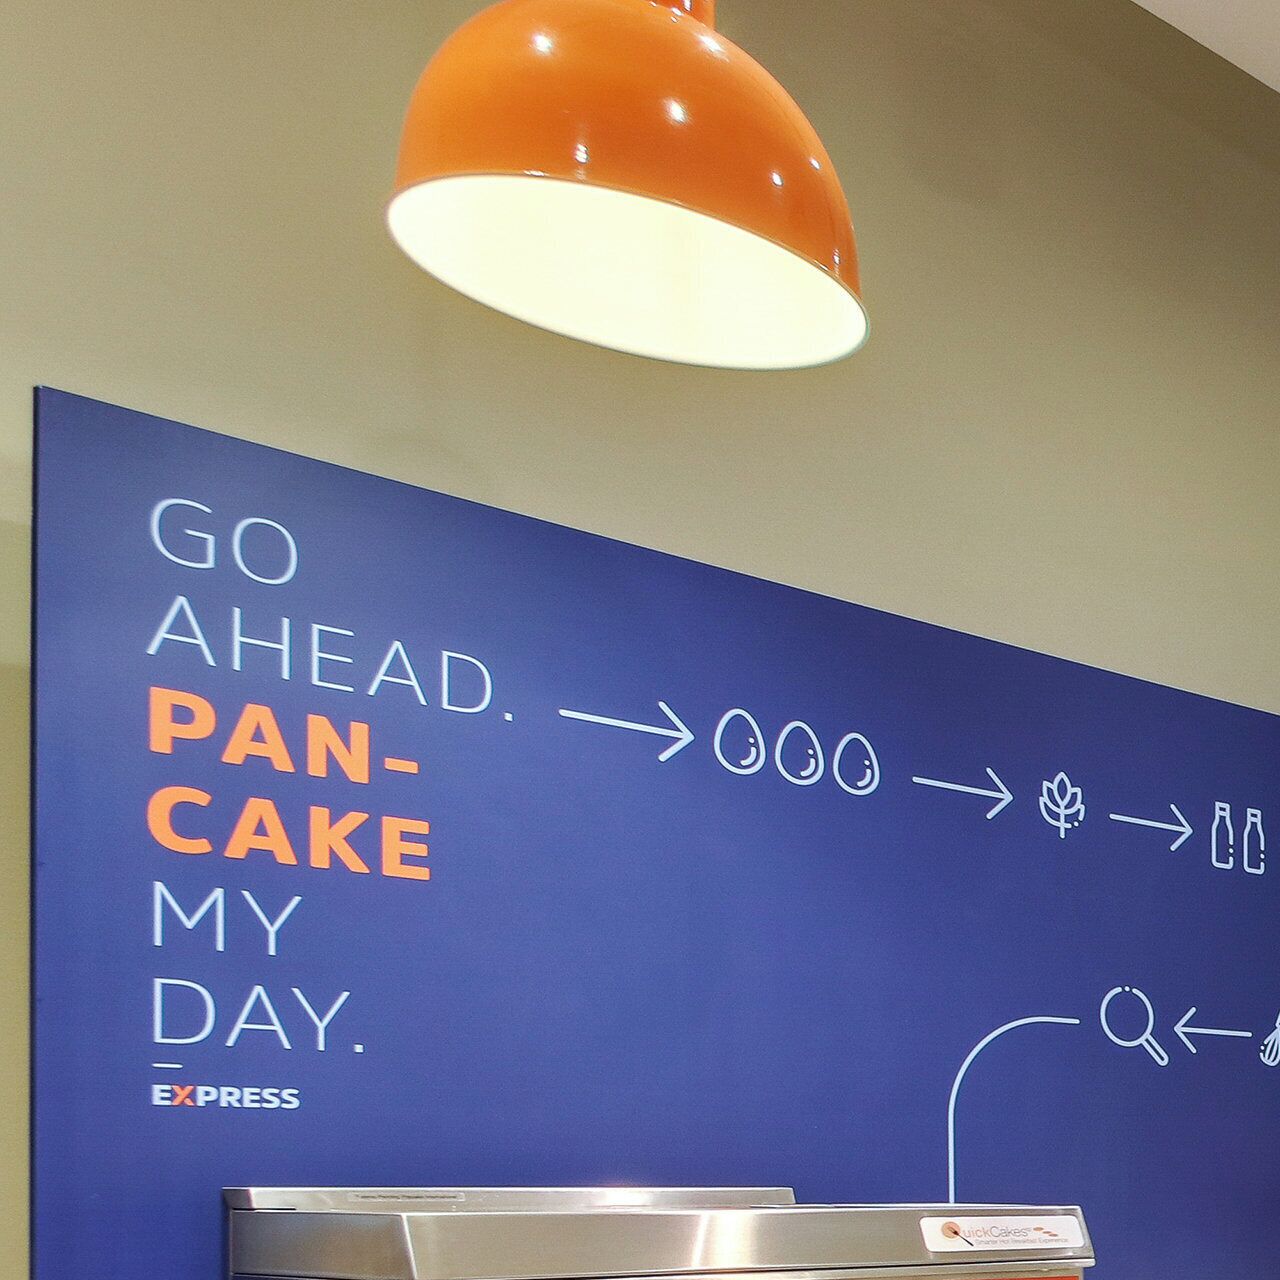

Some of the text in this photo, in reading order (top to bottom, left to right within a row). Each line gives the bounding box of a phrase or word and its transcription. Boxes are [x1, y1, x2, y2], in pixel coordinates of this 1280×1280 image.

[148, 497, 298, 585] GO
[146, 595, 514, 722] AHEAD.
[148, 685, 420, 785] PAN-
[146, 785, 431, 881] CAKE
[152, 880, 302, 957] MY
[152, 977, 365, 1054] DAY.
[151, 1084, 300, 1110] EXPRESS
